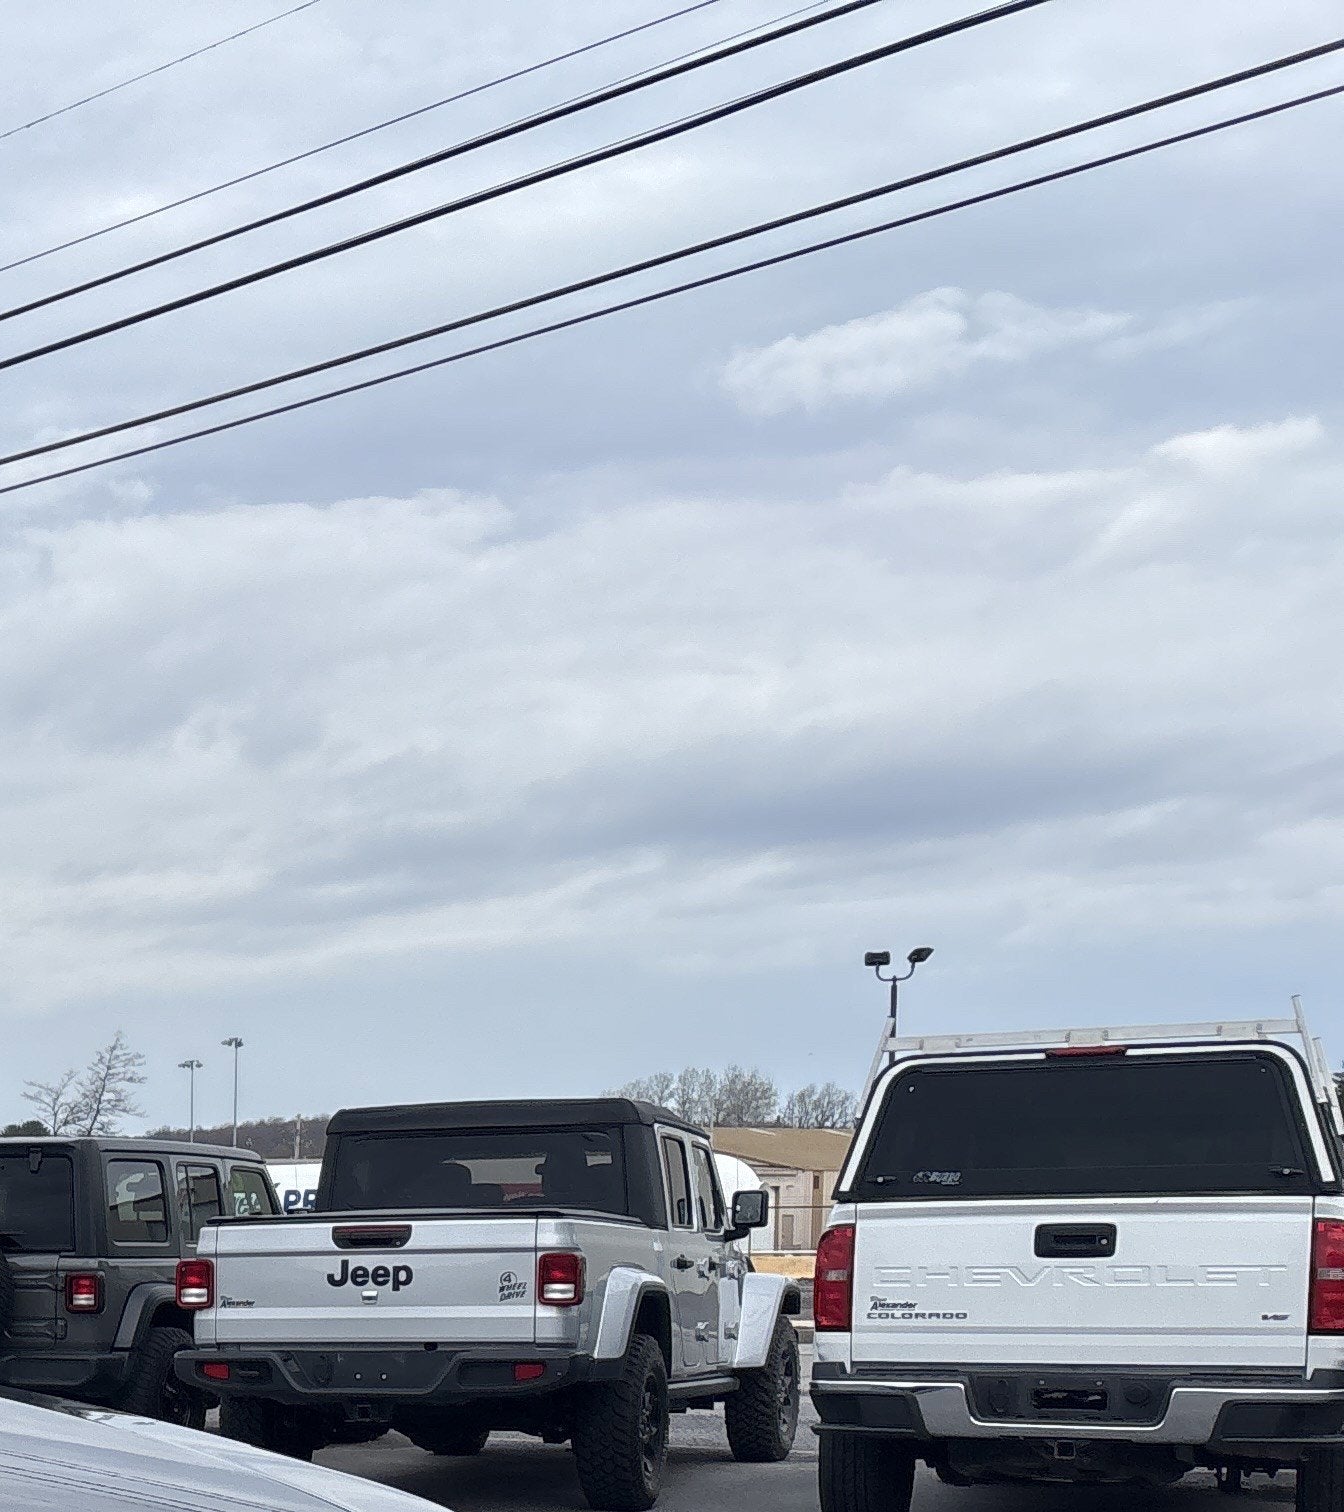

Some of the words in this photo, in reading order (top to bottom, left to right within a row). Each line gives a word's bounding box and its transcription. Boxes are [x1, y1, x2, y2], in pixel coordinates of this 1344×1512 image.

[327, 1258, 414, 1292] Jeep
[872, 1264, 1288, 1289] CHEVROLET
[866, 1312, 968, 1320] COLORADO
